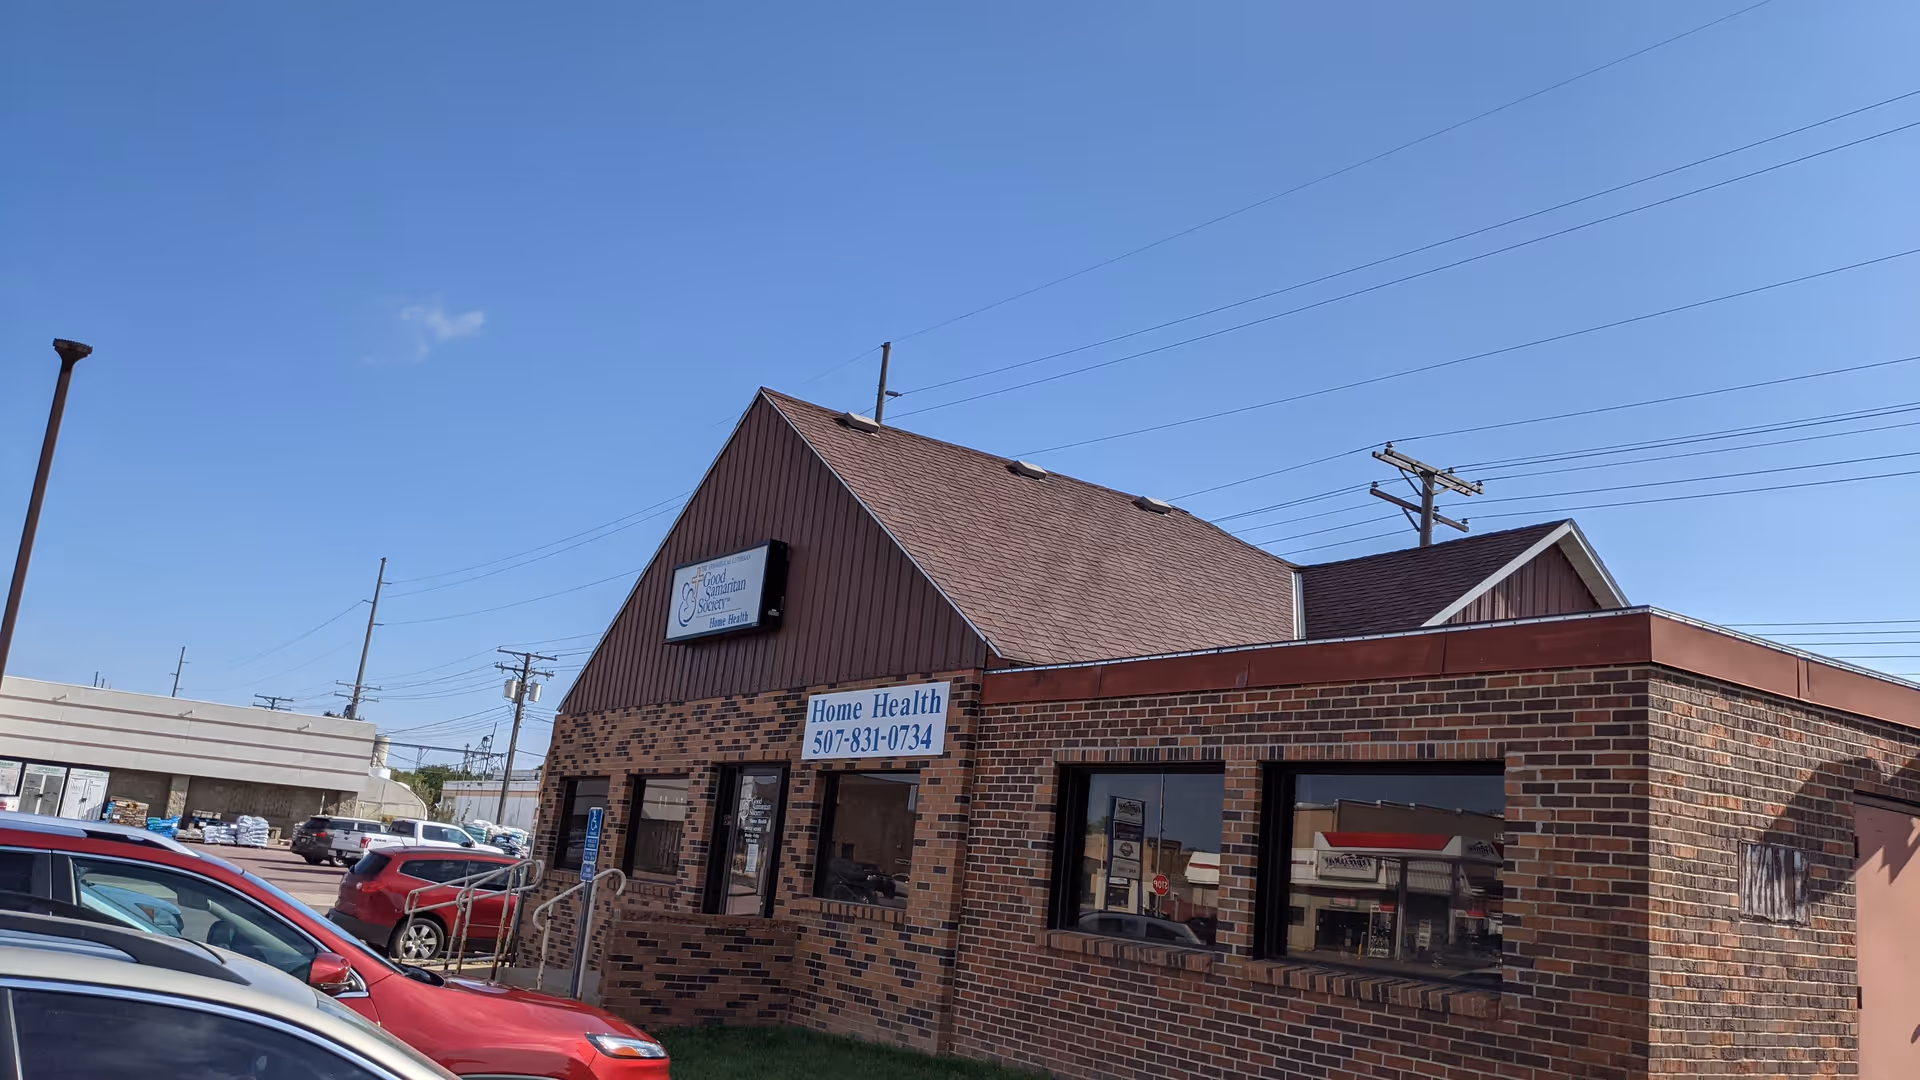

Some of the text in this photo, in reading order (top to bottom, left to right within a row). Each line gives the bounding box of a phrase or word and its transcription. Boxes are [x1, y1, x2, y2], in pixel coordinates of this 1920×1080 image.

[703, 568, 727, 588] Good
[706, 578, 746, 601] Samaritan
[709, 611, 749, 628] Home Health
[811, 688, 942, 723] Home Health
[812, 723, 933, 754] 507-831-0734
